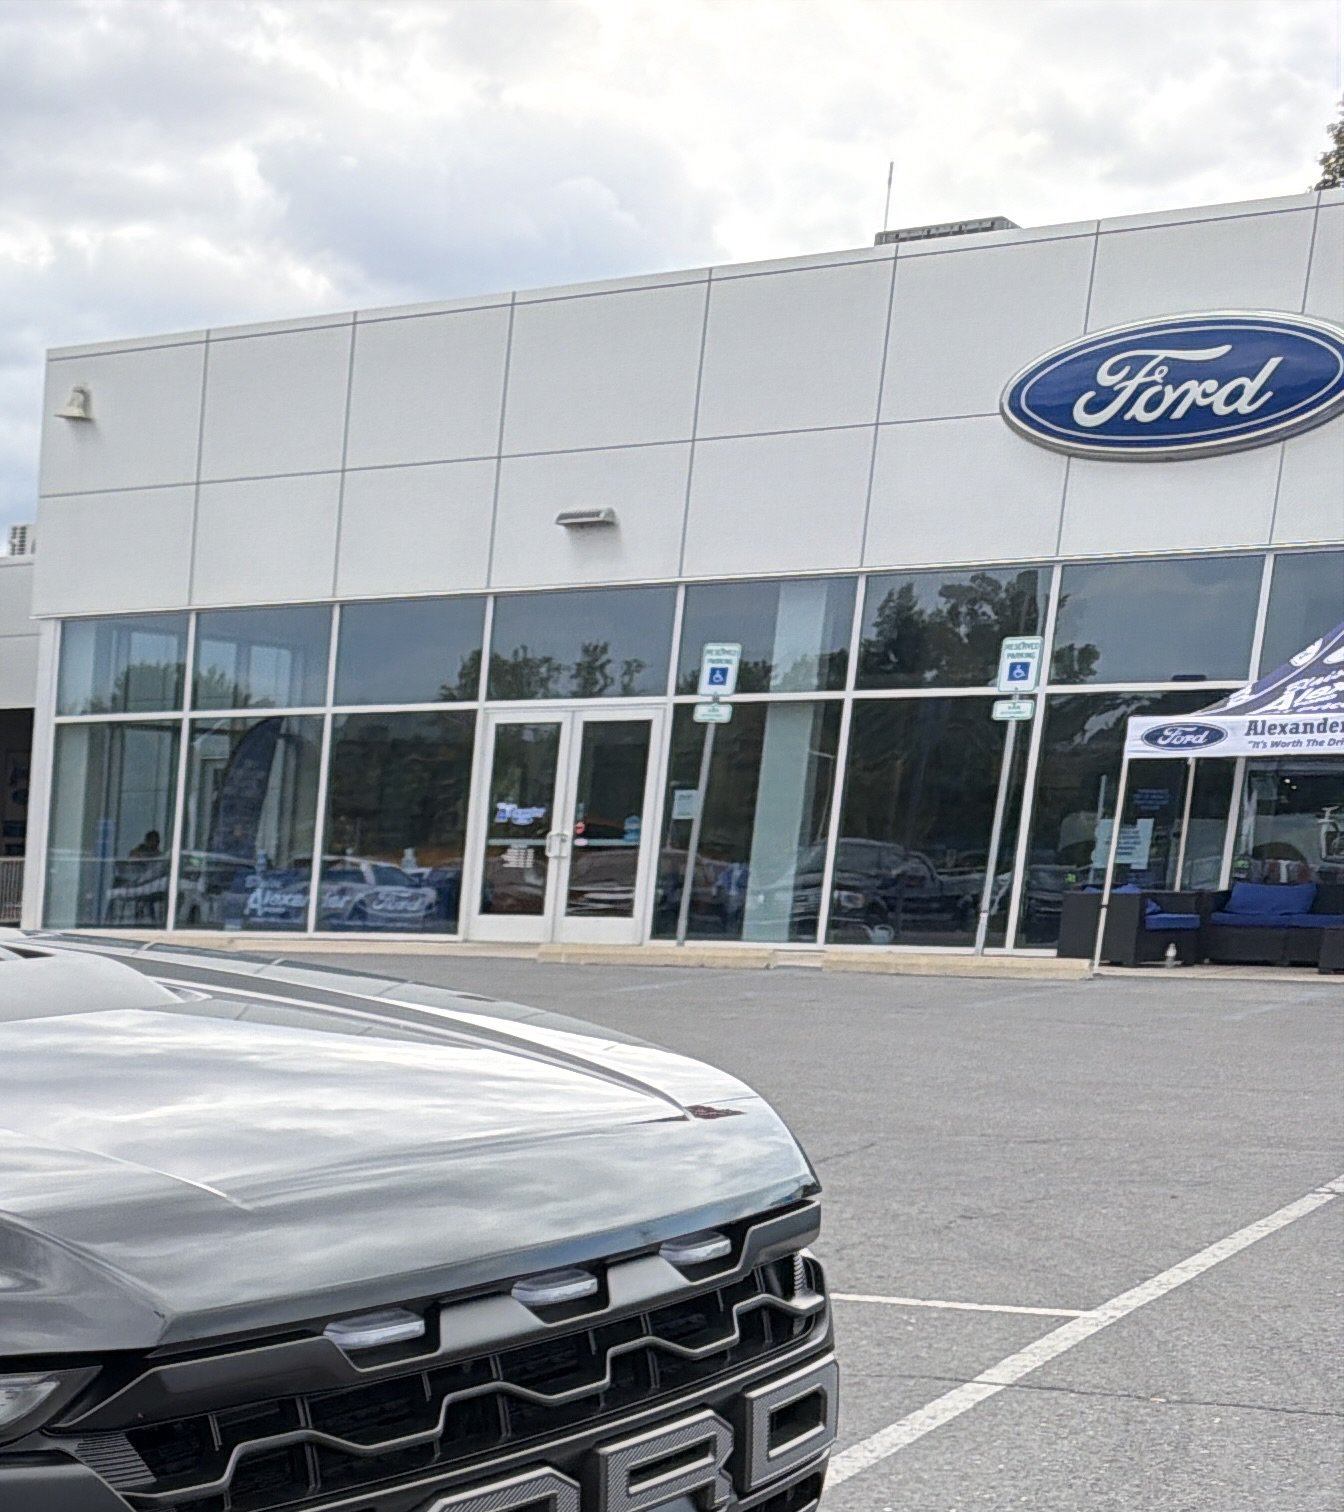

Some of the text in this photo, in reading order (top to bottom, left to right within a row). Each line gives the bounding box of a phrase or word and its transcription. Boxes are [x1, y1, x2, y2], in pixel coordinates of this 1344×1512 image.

[1073, 345, 1283, 427] Ford
[1157, 727, 1209, 745] Ford
[1270, 740, 1303, 748] Worth
[1306, 739, 1325, 748] The
